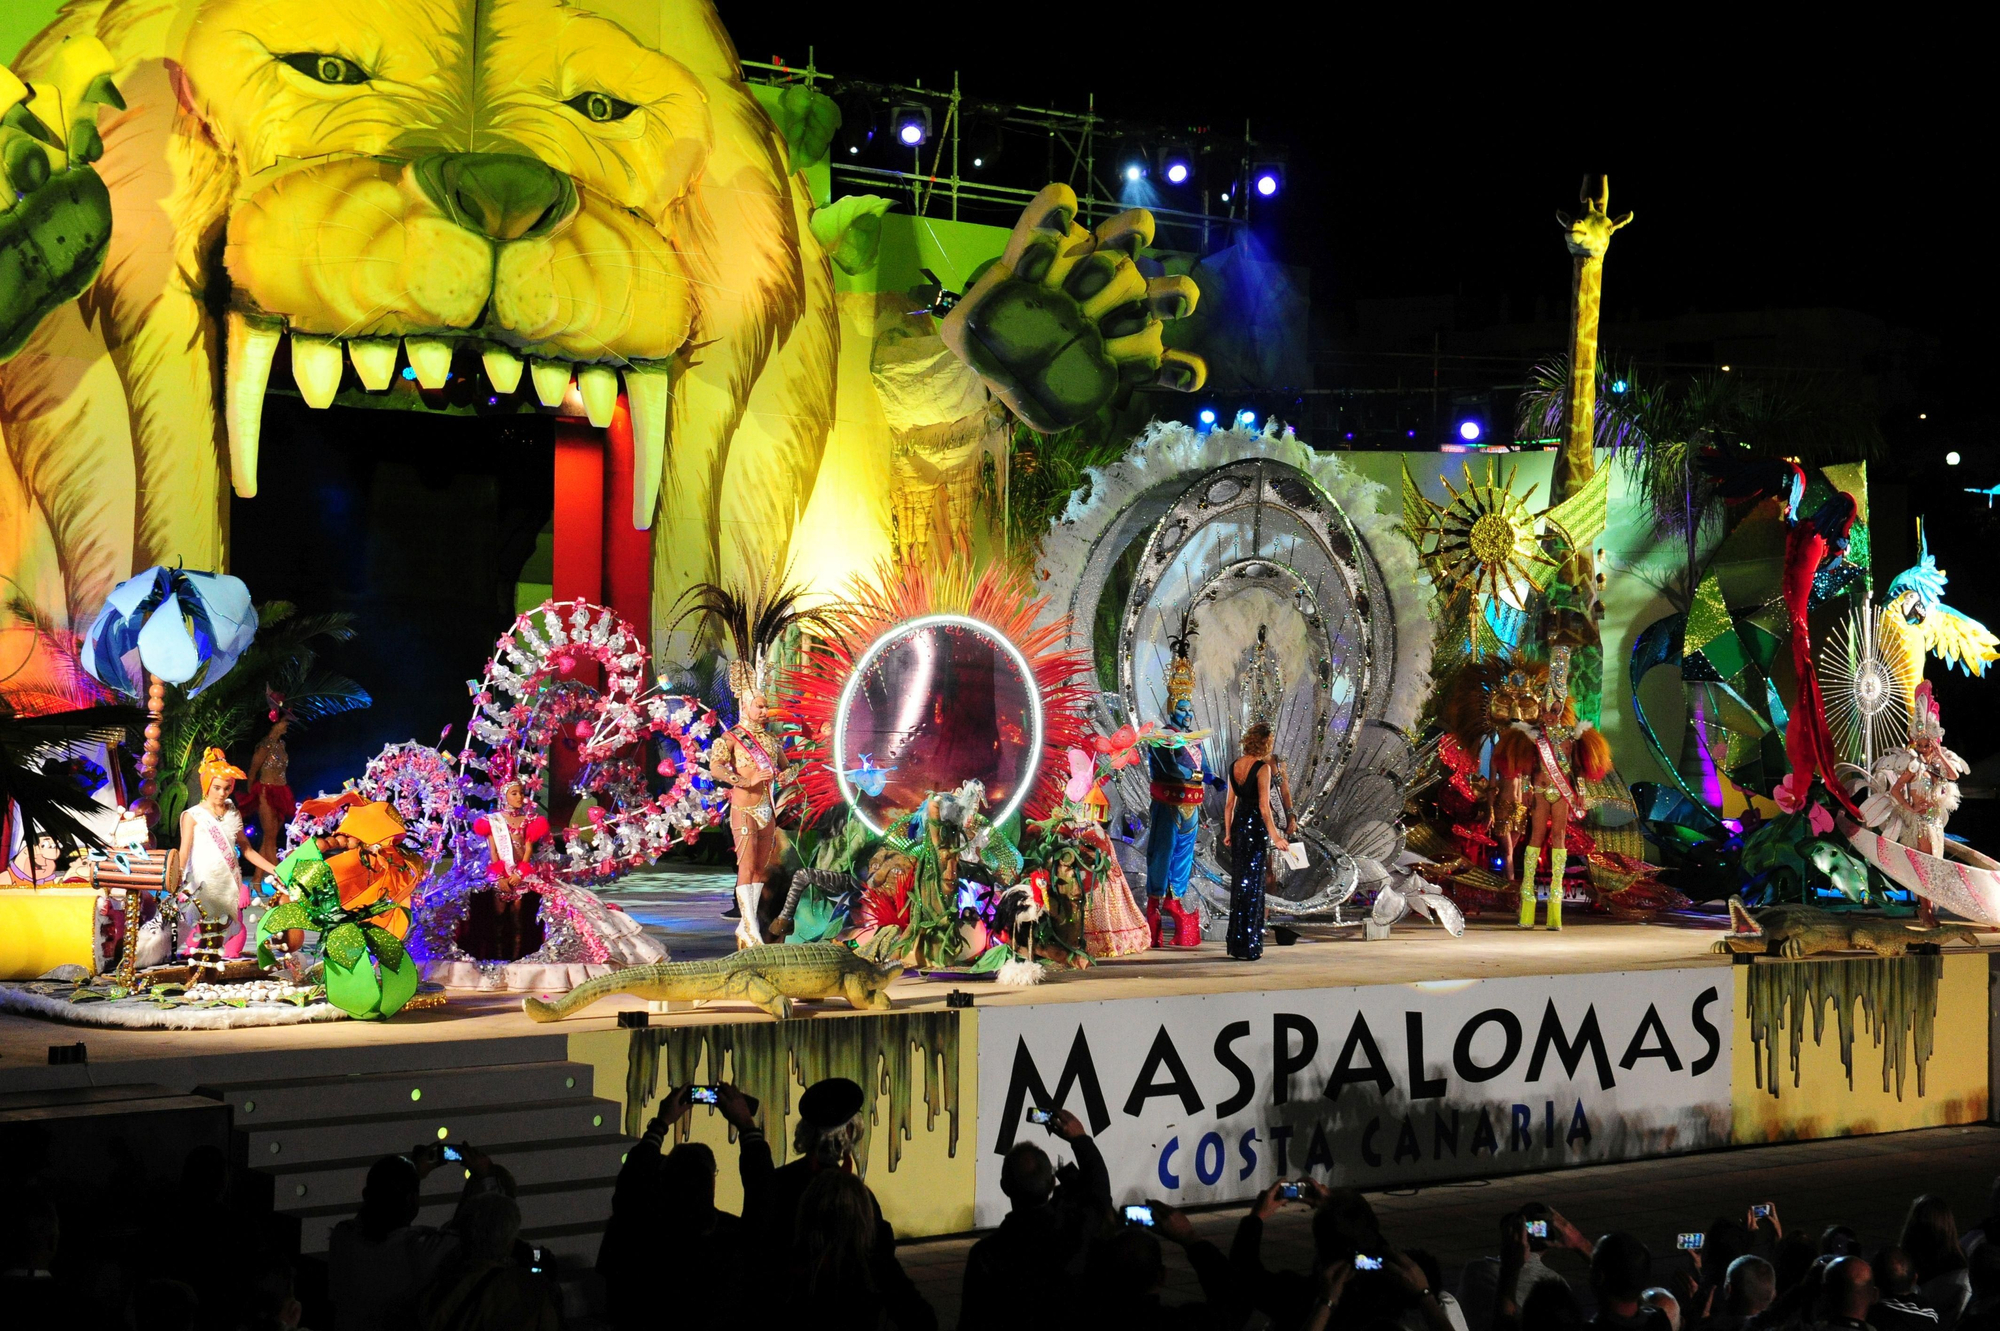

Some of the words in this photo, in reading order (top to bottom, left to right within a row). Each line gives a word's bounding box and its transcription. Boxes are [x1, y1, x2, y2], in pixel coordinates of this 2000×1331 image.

[208, 825, 228, 852] SEGUNDA
[498, 834, 509, 858] PRIMERA
[994, 985, 1721, 1156] MASPALOMAS
[1158, 1122, 1335, 1190] COSTA
[1361, 1096, 1593, 1168] CANARIA
